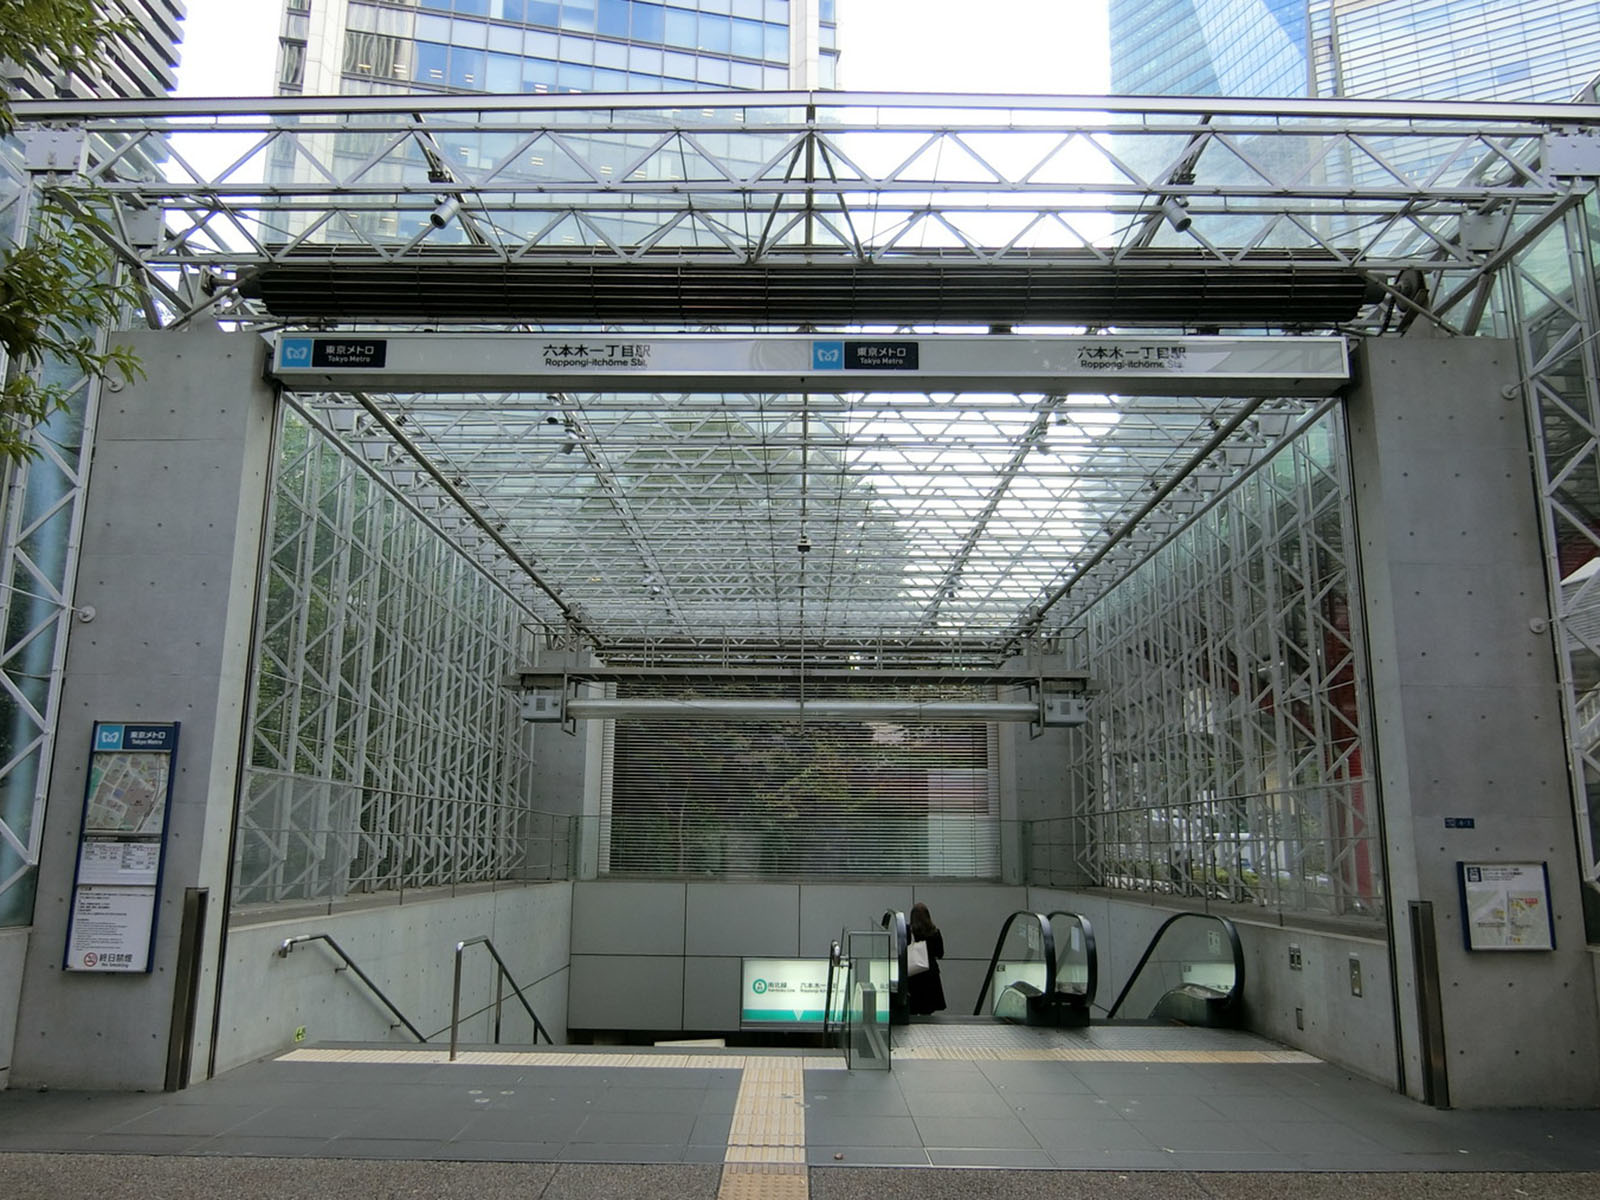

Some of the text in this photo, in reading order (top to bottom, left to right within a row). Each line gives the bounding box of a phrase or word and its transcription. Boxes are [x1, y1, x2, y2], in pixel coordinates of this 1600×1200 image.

[325, 345, 375, 355] 東京メトロ
[543, 344, 651, 358] 六本木一丁目駅
[857, 347, 907, 357] 東京メトロ
[1077, 346, 1186, 360] 六本木一丁目駅
[328, 355, 348, 363] Tokyo
[860, 357, 881, 365] Tokyo
